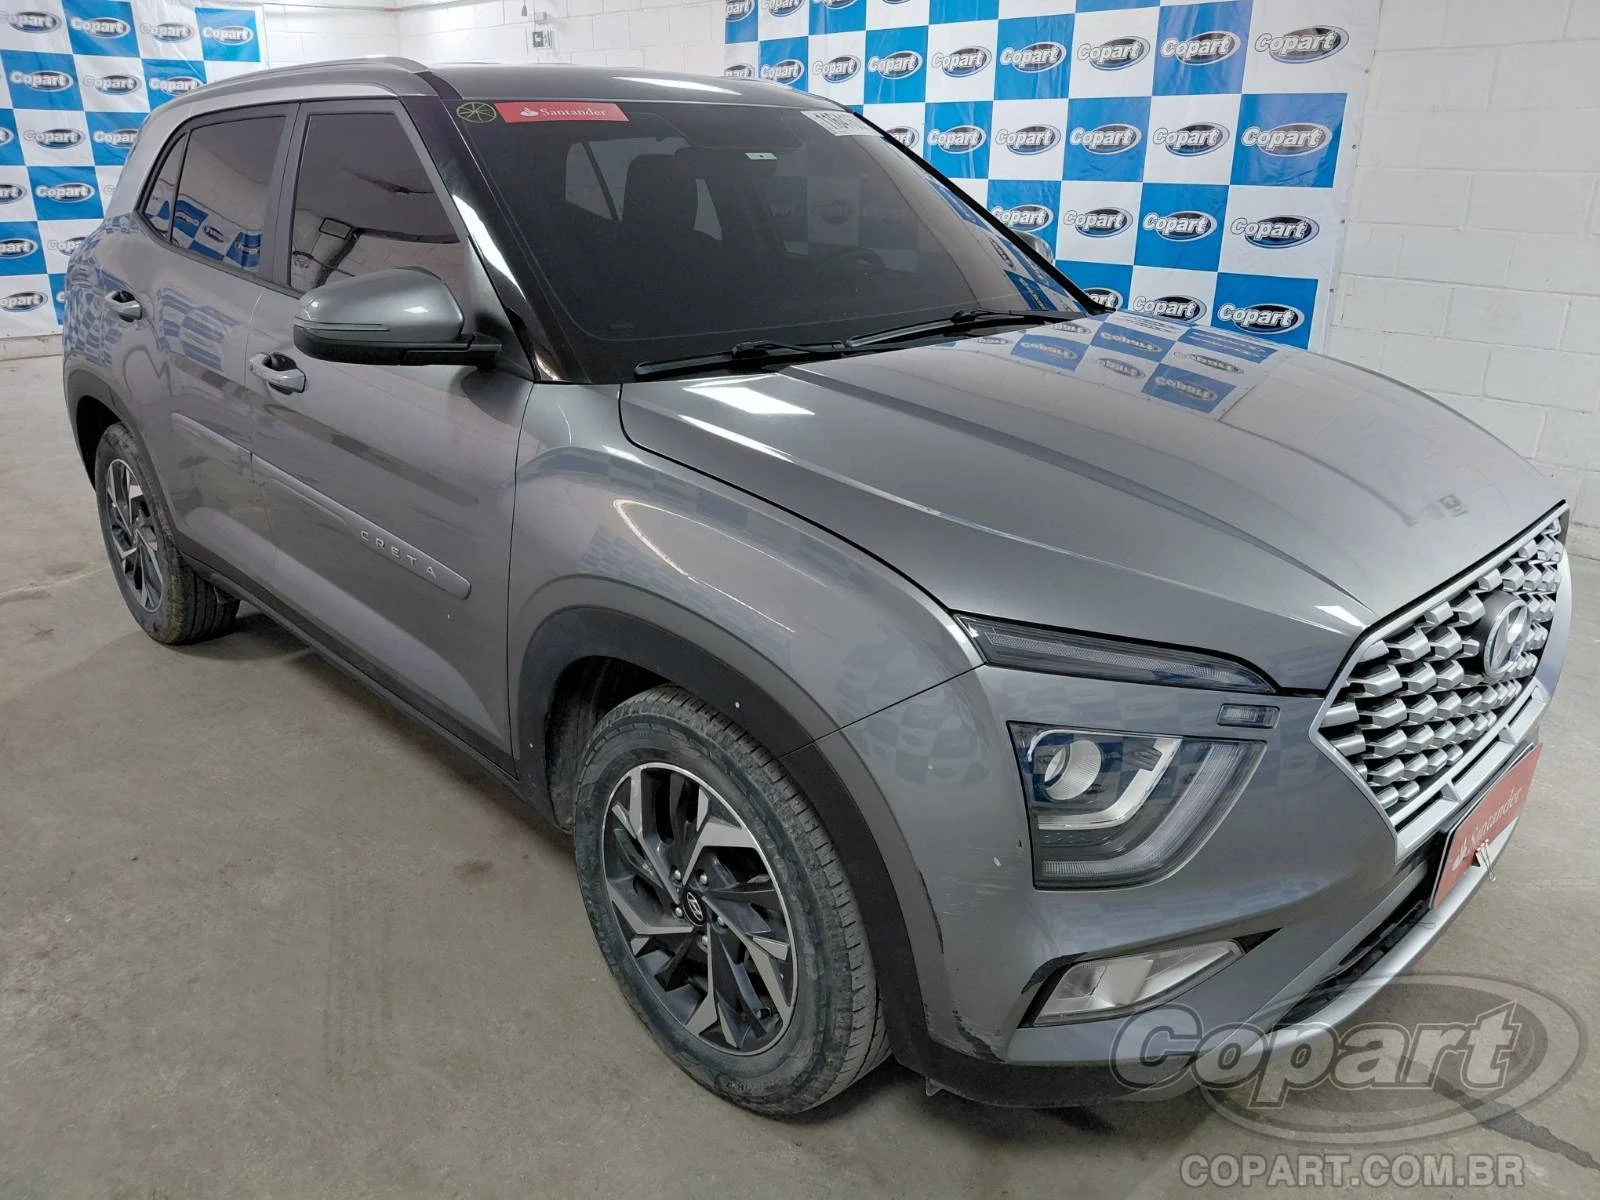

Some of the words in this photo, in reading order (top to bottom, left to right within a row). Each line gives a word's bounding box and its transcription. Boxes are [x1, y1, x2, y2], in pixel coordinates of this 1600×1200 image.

[71, 17, 124, 37] Copart
[140, 23, 189, 41] Copart
[203, 26, 247, 44] Copart
[1077, 36, 1142, 67] Copart
[1161, 33, 1233, 62] Copart
[1255, 26, 1337, 59] Copart
[868, 54, 915, 75] Copart
[931, 50, 985, 73] Copart
[1000, 42, 1059, 67] Copart
[10, 70, 67, 88] Copart
[760, 63, 800, 80] Copart
[812, 59, 857, 78] Copart
[83, 75, 136, 93] Copart
[149, 78, 198, 95] Copart
[539, 107, 607, 116] Santander
[24, 129, 78, 148] Copart
[928, 129, 982, 151] Copart
[995, 128, 1053, 149] Copart
[1070, 127, 1137, 149] Copart
[1153, 127, 1220, 151] Copart
[1241, 126, 1325, 152] Copart
[35, 184, 88, 200] Copart
[1063, 209, 1126, 233] Copart
[1142, 212, 1210, 237] Copart
[1230, 216, 1309, 246] Copart
[1132, 295, 1198, 321] Copart
[1217, 302, 1295, 332] Copart
[360, 530, 437, 579] CRETA
